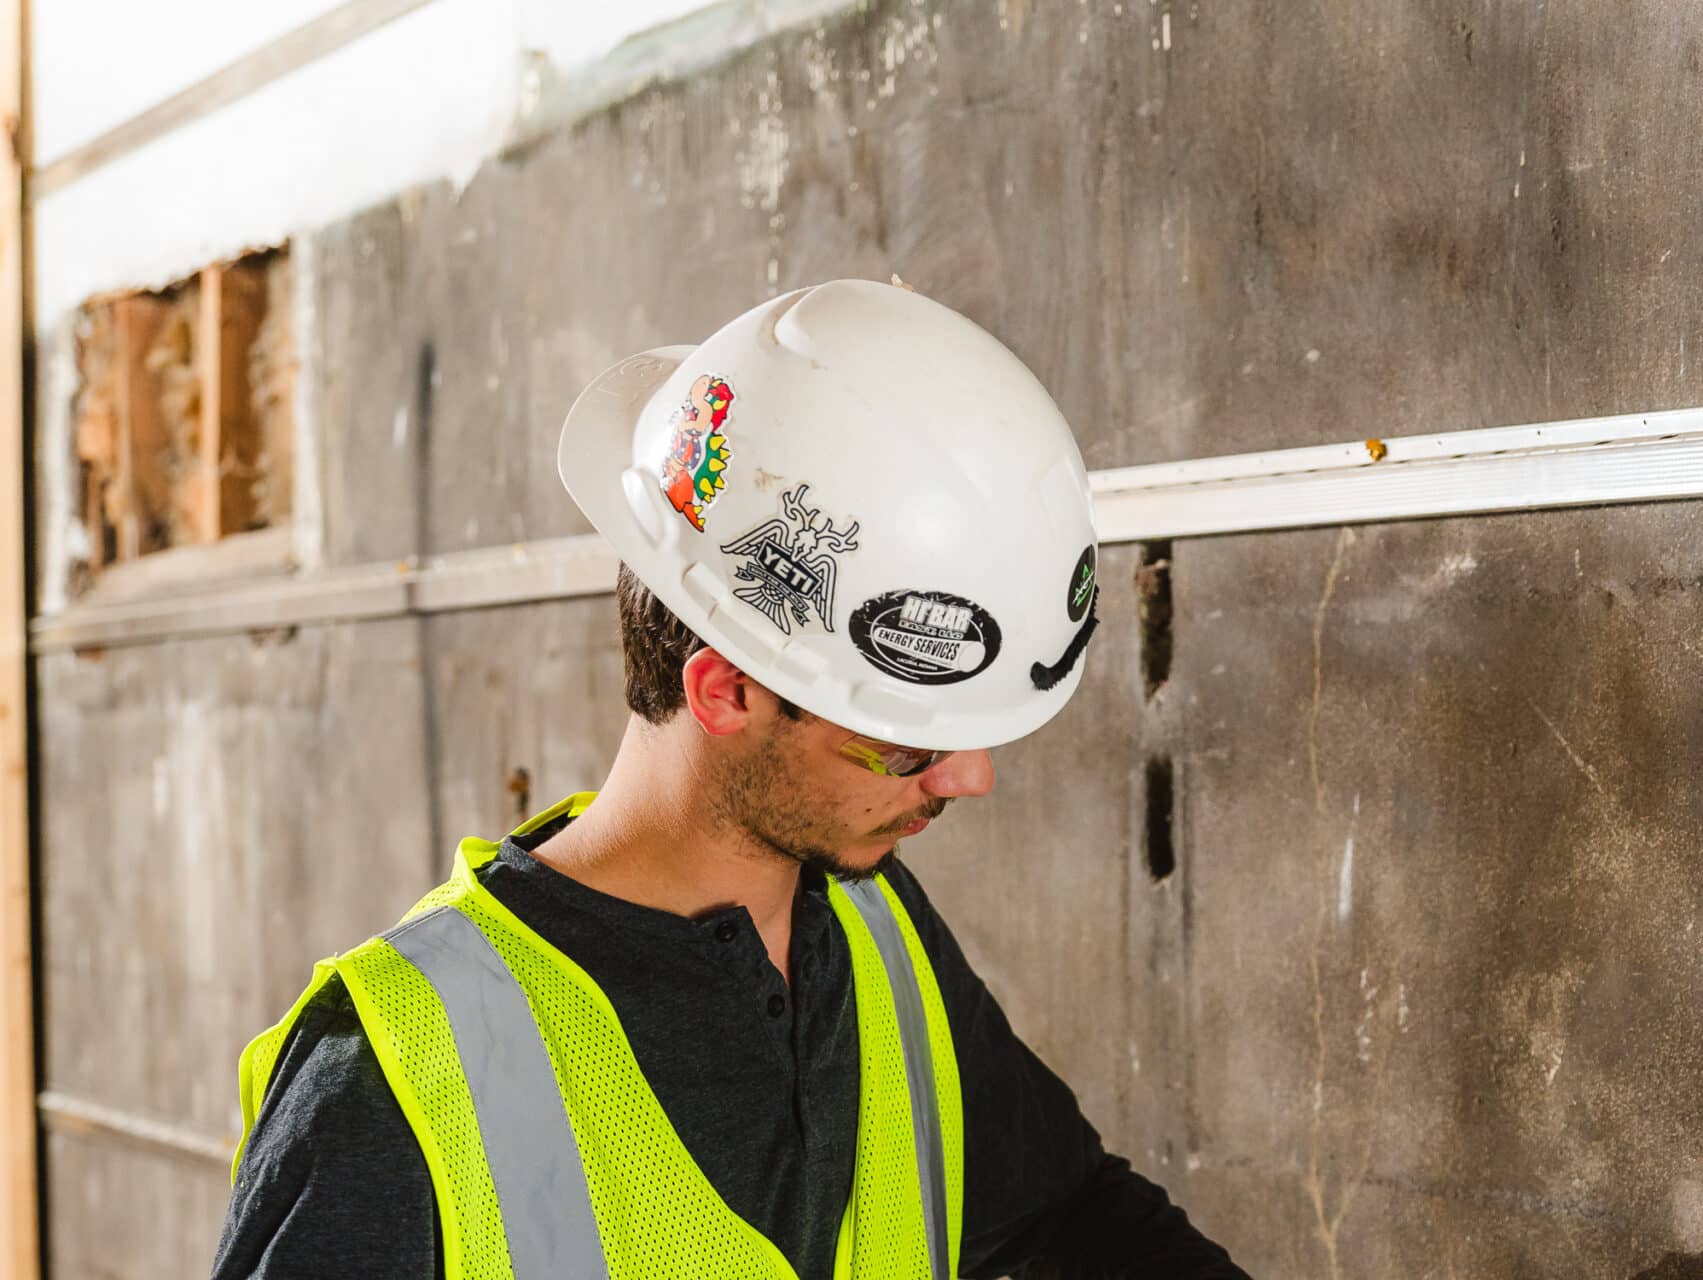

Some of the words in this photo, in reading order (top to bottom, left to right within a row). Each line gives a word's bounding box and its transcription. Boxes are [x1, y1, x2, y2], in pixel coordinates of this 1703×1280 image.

[763, 545, 814, 593] YETI
[878, 629, 915, 648] ENERGY
[914, 638, 961, 661] SERVICES
